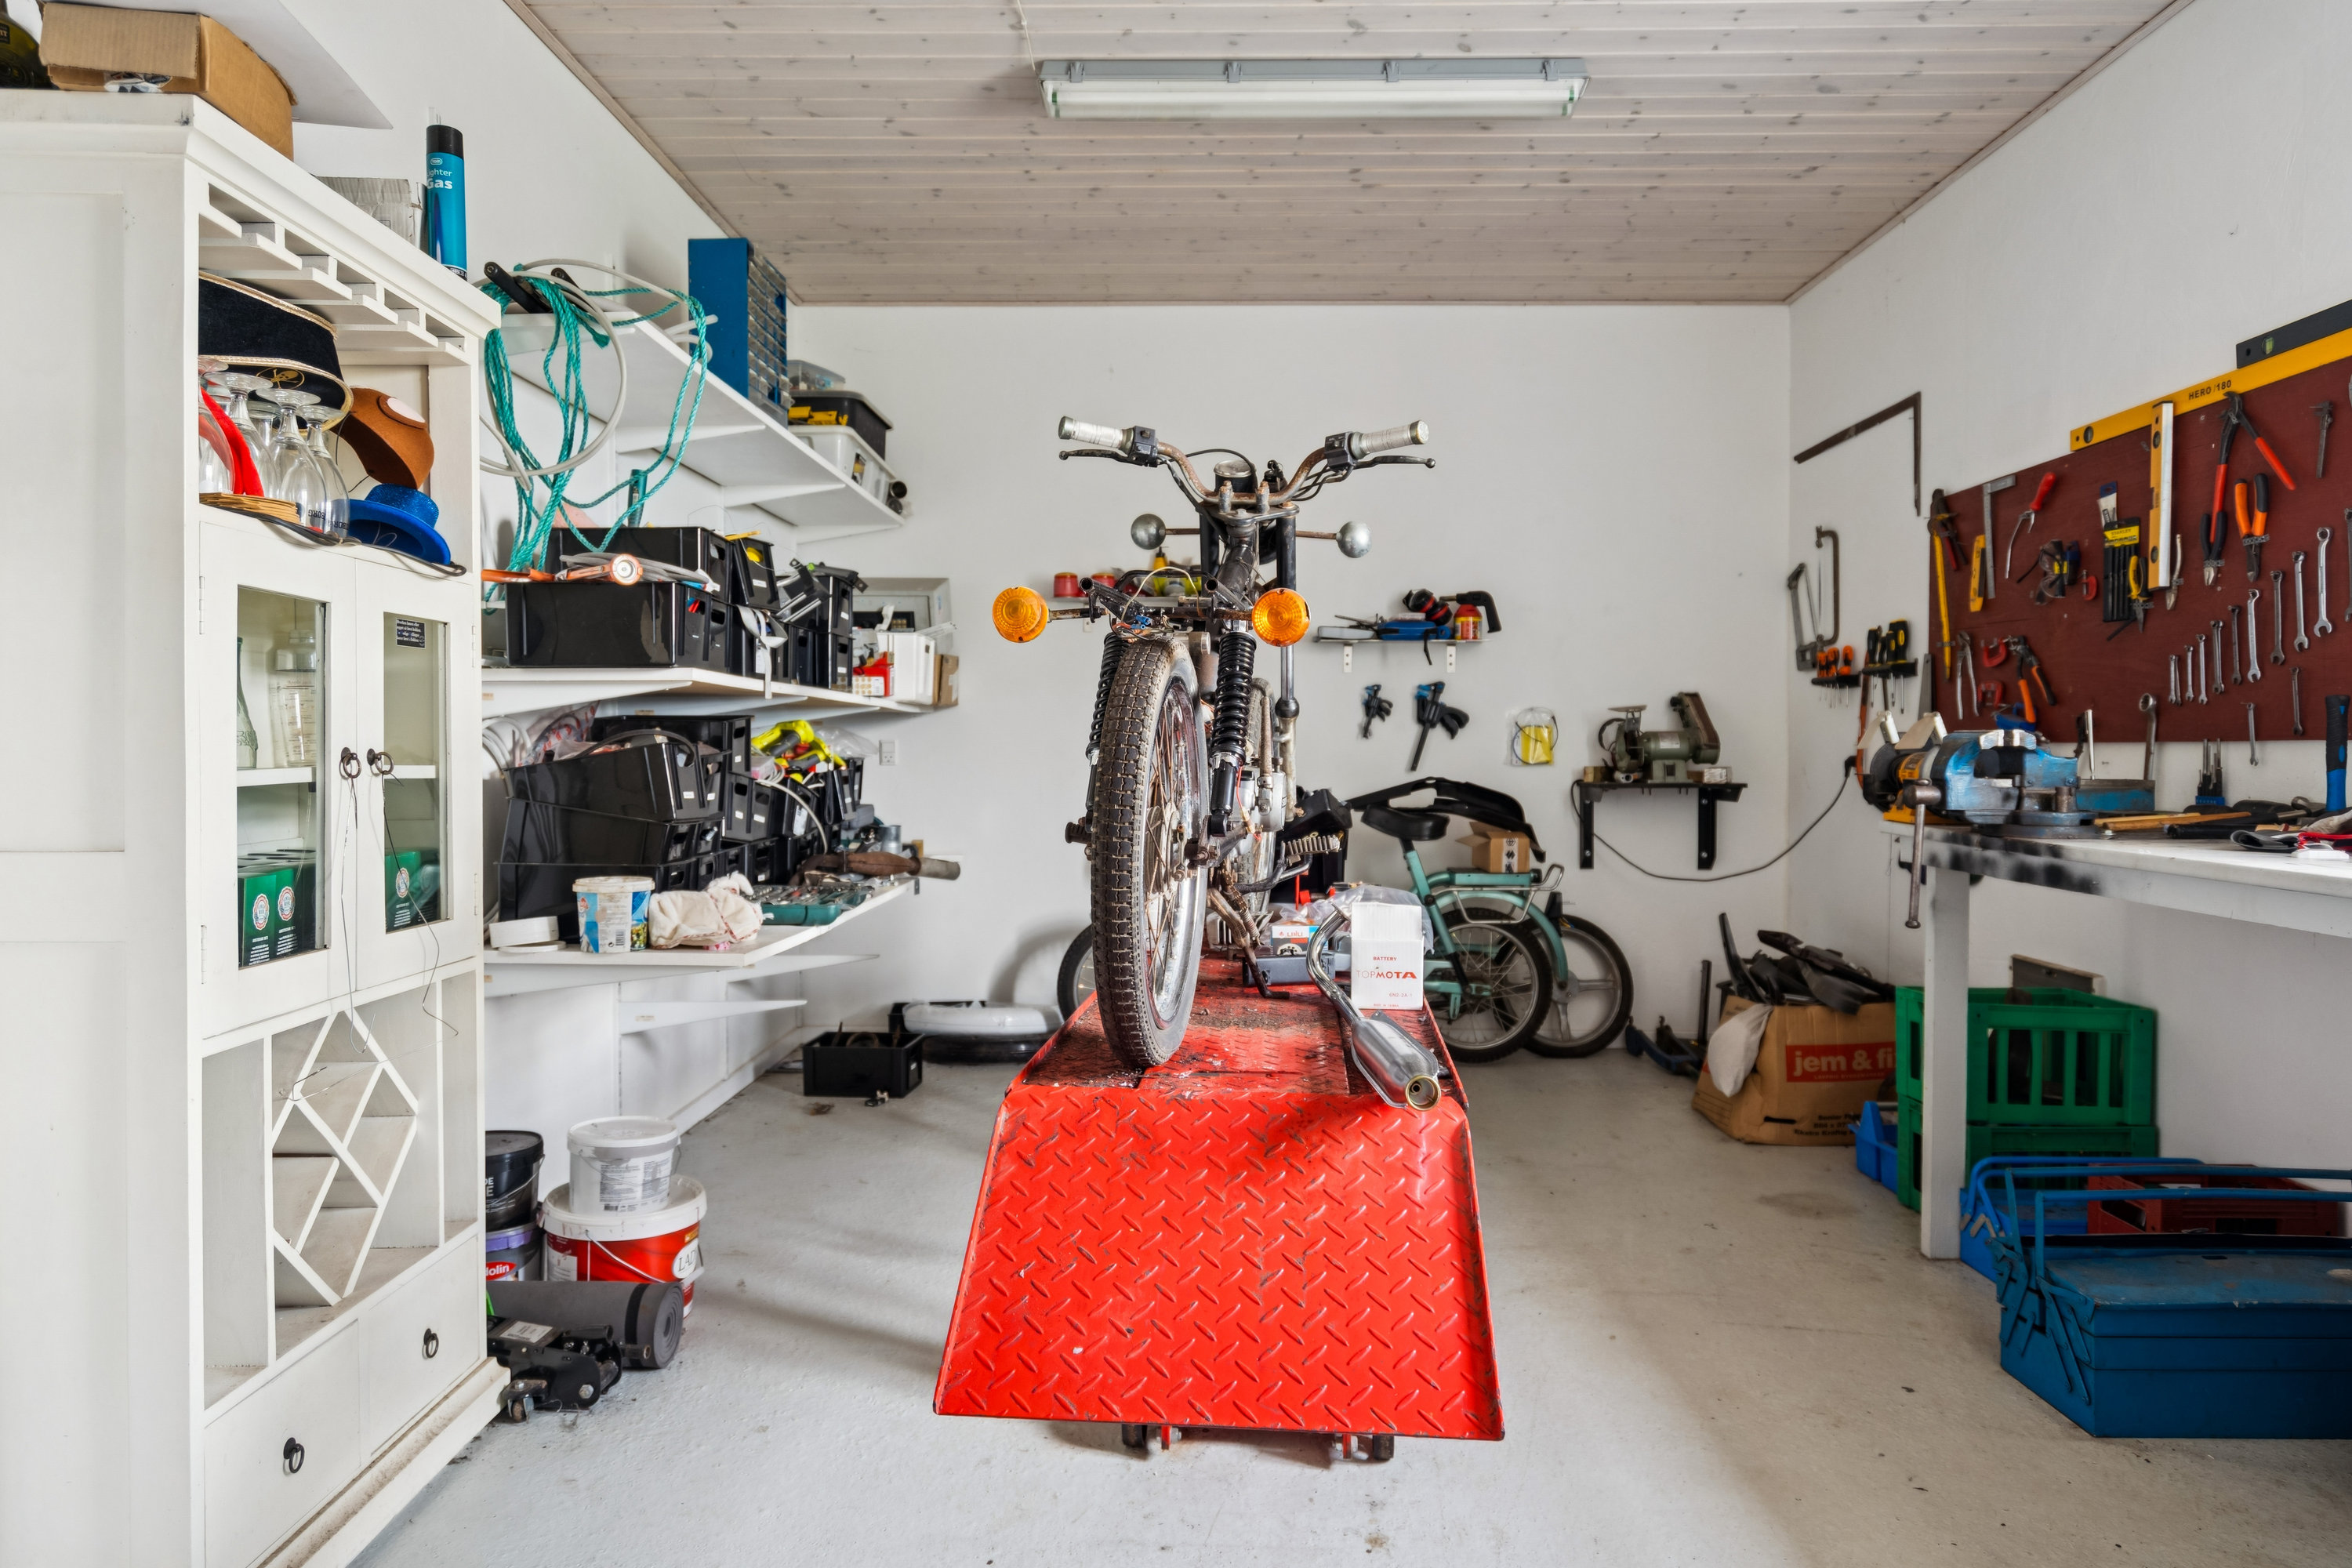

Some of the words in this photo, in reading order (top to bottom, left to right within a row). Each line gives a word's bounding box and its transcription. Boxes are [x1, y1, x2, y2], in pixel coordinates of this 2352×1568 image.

[426, 177, 452, 190] Gas
[2188, 386, 2212, 401] HERO
[1355, 970, 1417, 979] TOPMOTA
[1793, 1051, 1847, 1077] jem
[1851, 1050, 1873, 1071] &
[1875, 1047, 1896, 1069] fi
